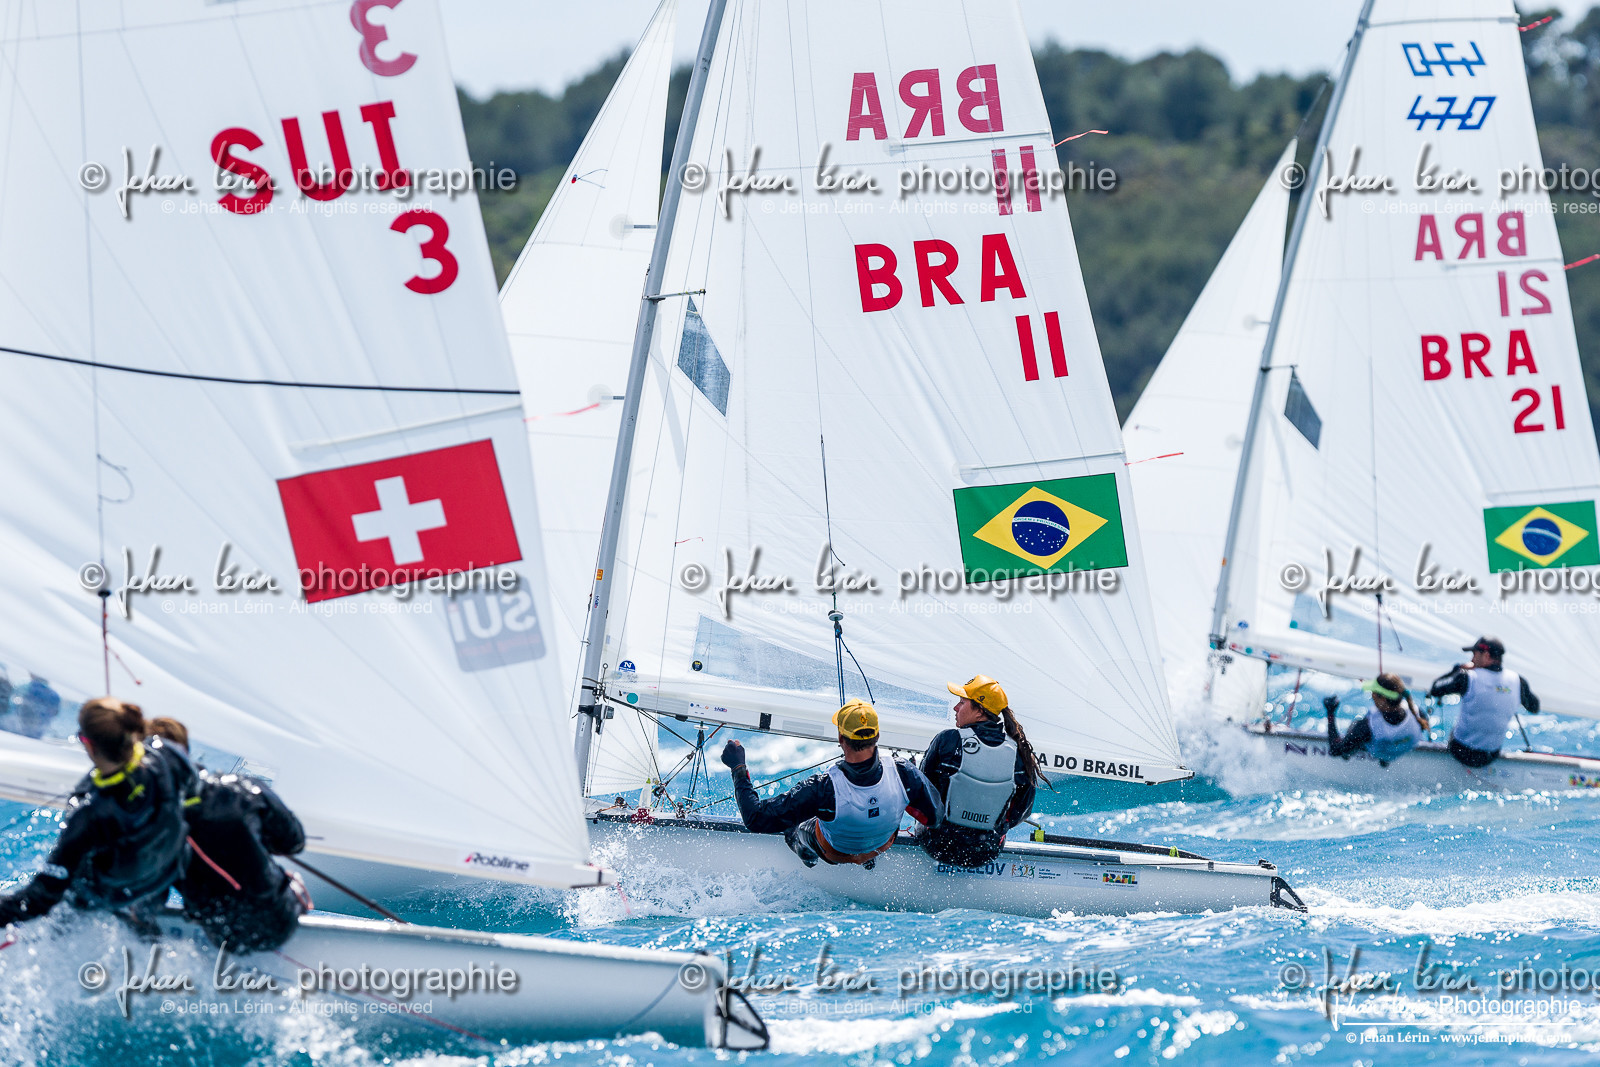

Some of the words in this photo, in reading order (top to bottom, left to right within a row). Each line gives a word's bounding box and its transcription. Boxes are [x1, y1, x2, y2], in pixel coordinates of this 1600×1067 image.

[1406, 95, 1496, 130] 470
[210, 100, 413, 215] SUI
[389, 209, 459, 295] 3
[854, 232, 1027, 313] BRA
[1015, 311, 1069, 381] 11
[1420, 328, 1538, 381] BRA
[1510, 384, 1565, 435] 21
[1054, 754, 1078, 770] DO
[1083, 759, 1144, 779] BRASIL
[961, 810, 990, 824] DUQUE
[464, 852, 529, 870] Robline
[1102, 873, 1138, 885] BRASIL
